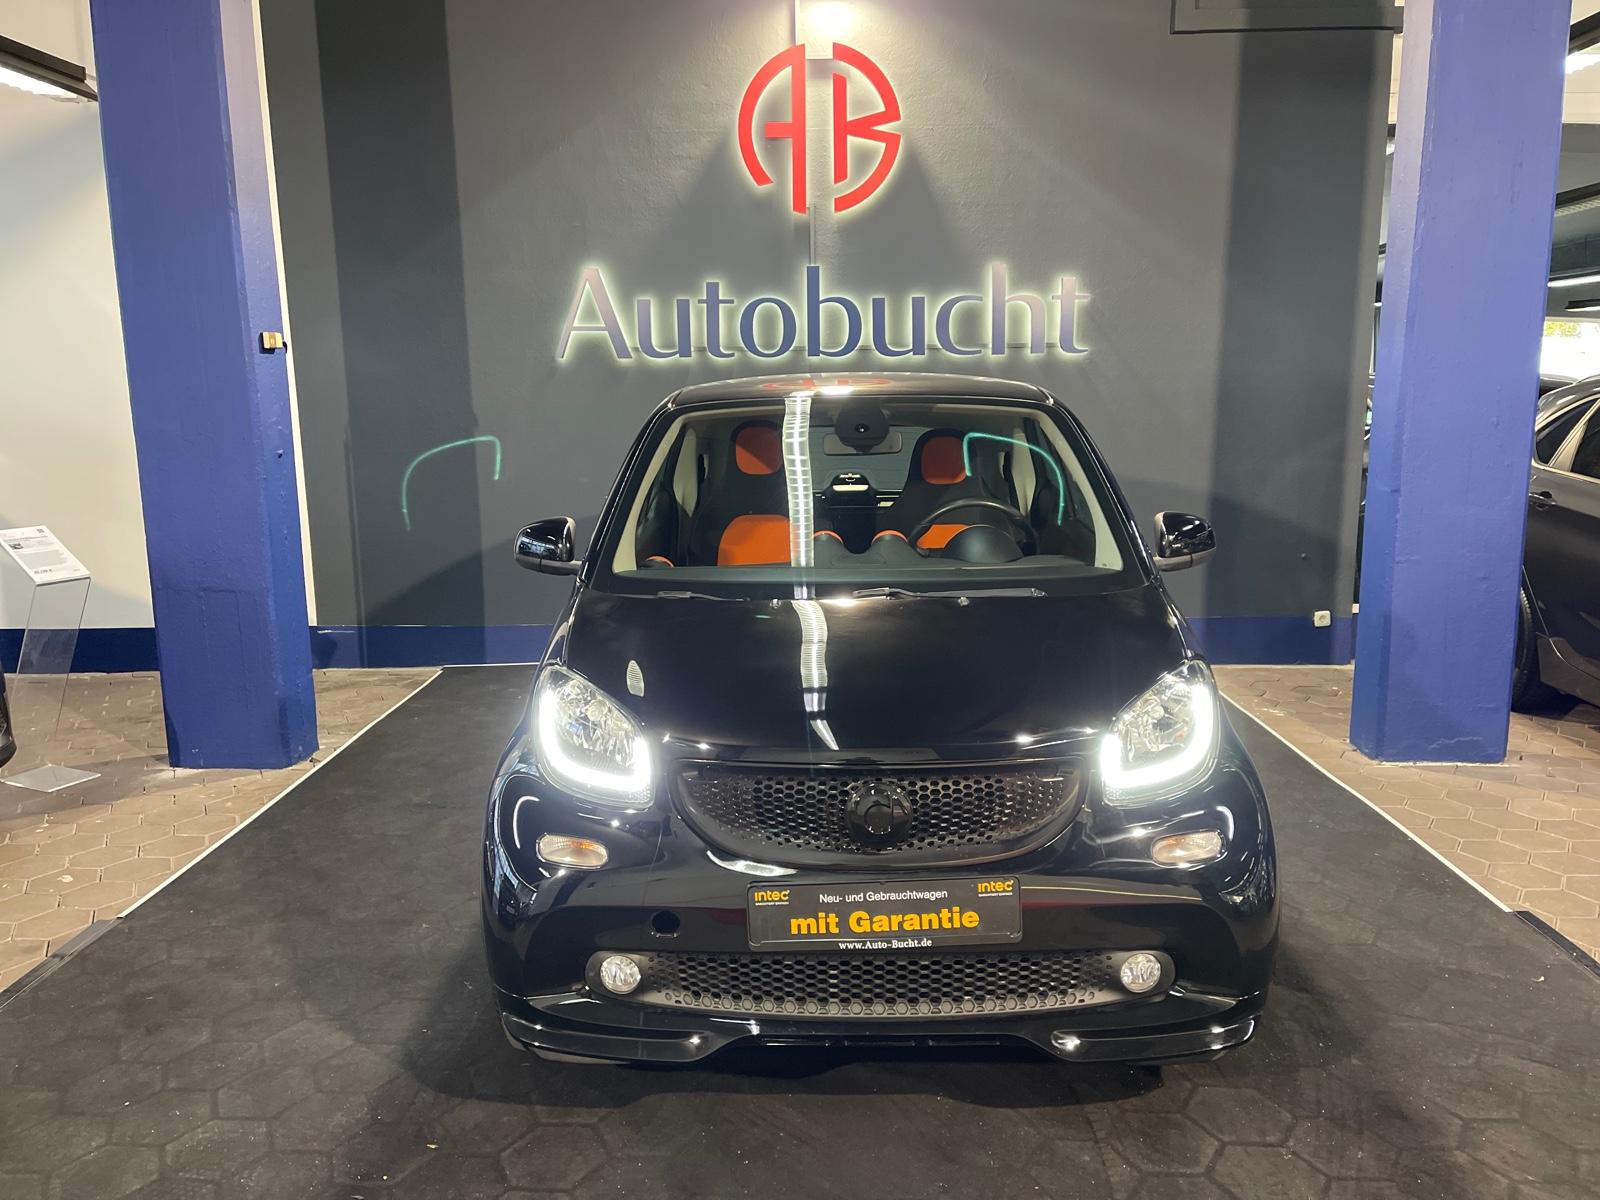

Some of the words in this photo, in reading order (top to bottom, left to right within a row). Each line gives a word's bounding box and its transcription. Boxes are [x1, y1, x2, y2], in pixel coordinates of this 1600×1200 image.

[737, 42, 902, 215] AB
[556, 263, 1092, 360] Autobucht
[977, 880, 1014, 892] intec
[754, 889, 790, 902] intec
[819, 893, 843, 904] Neu-
[845, 891, 864, 902] und
[866, 889, 948, 902] Gebrauchtwagen
[790, 912, 839, 935] mit
[849, 906, 980, 933] Garantie
[838, 939, 933, 950] www.Auto-Bucht.de
